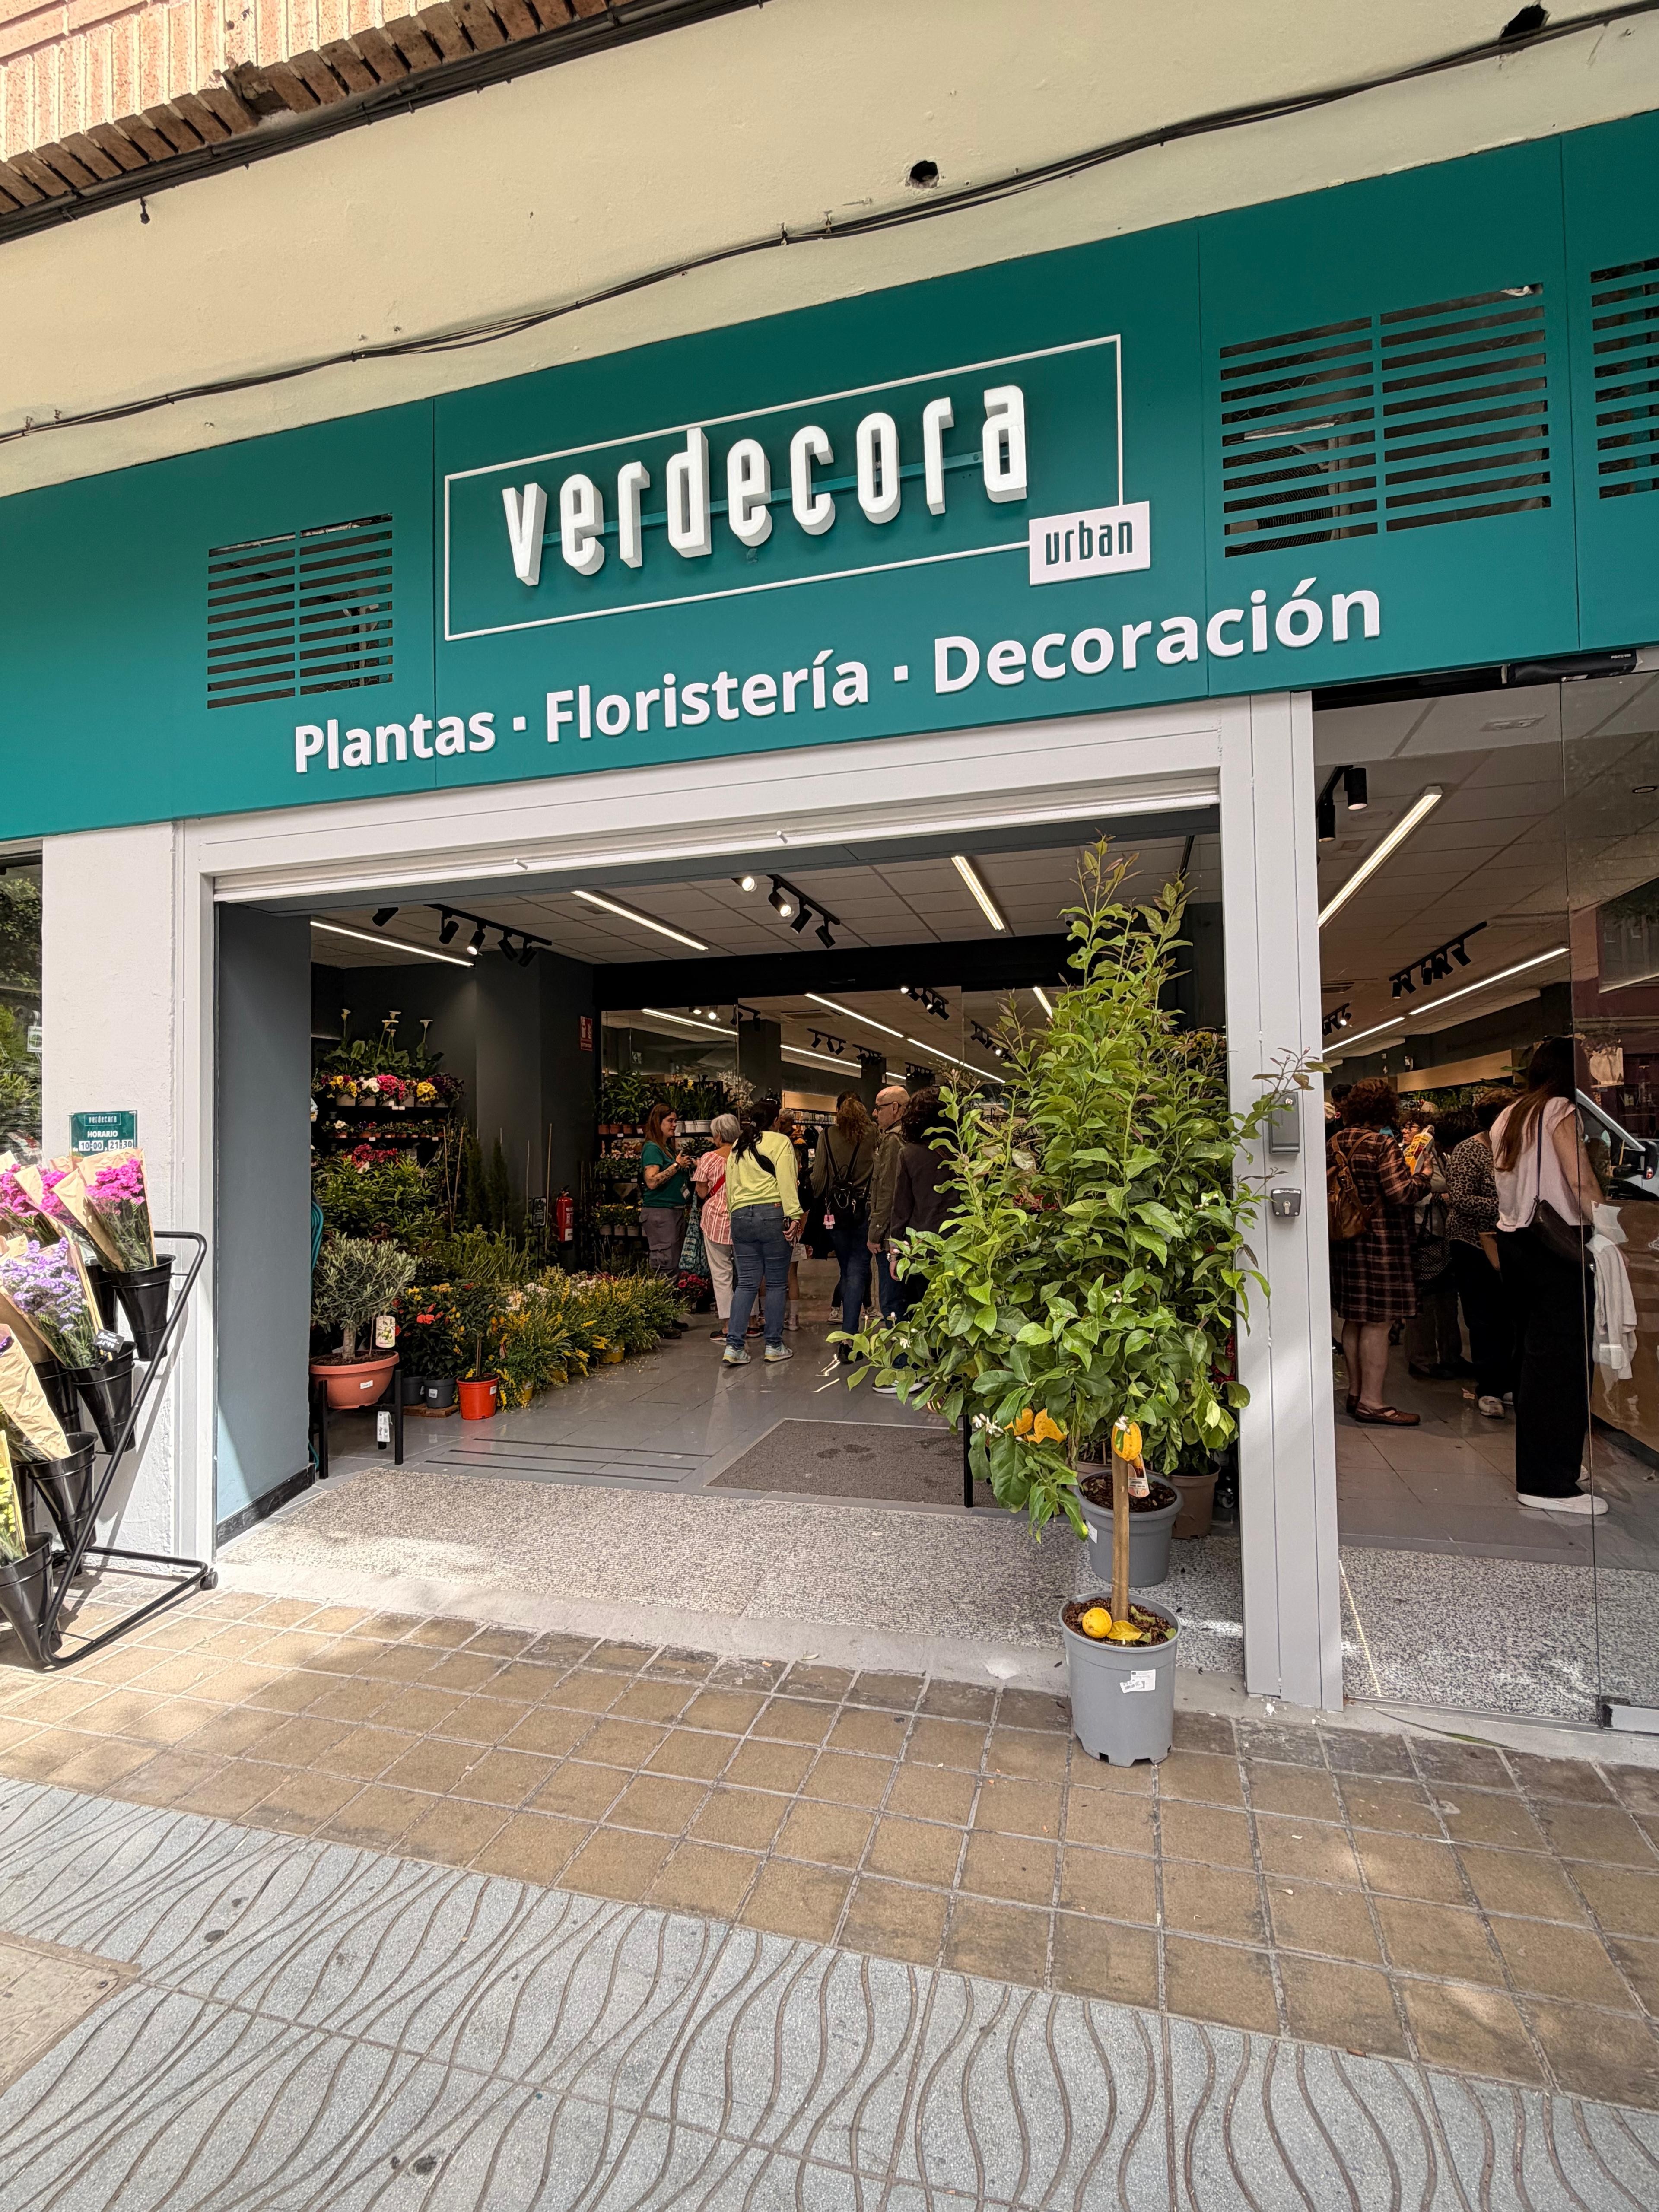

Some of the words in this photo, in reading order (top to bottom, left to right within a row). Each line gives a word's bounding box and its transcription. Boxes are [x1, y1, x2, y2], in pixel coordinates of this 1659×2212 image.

[502, 385, 1027, 586] verdecora
[1046, 521, 1133, 565] urban
[295, 712, 496, 773] Plantas
[547, 650, 868, 742] Floristería
[934, 578, 1380, 693] Decoración
[109, 1141, 133, 1149] 21:30
